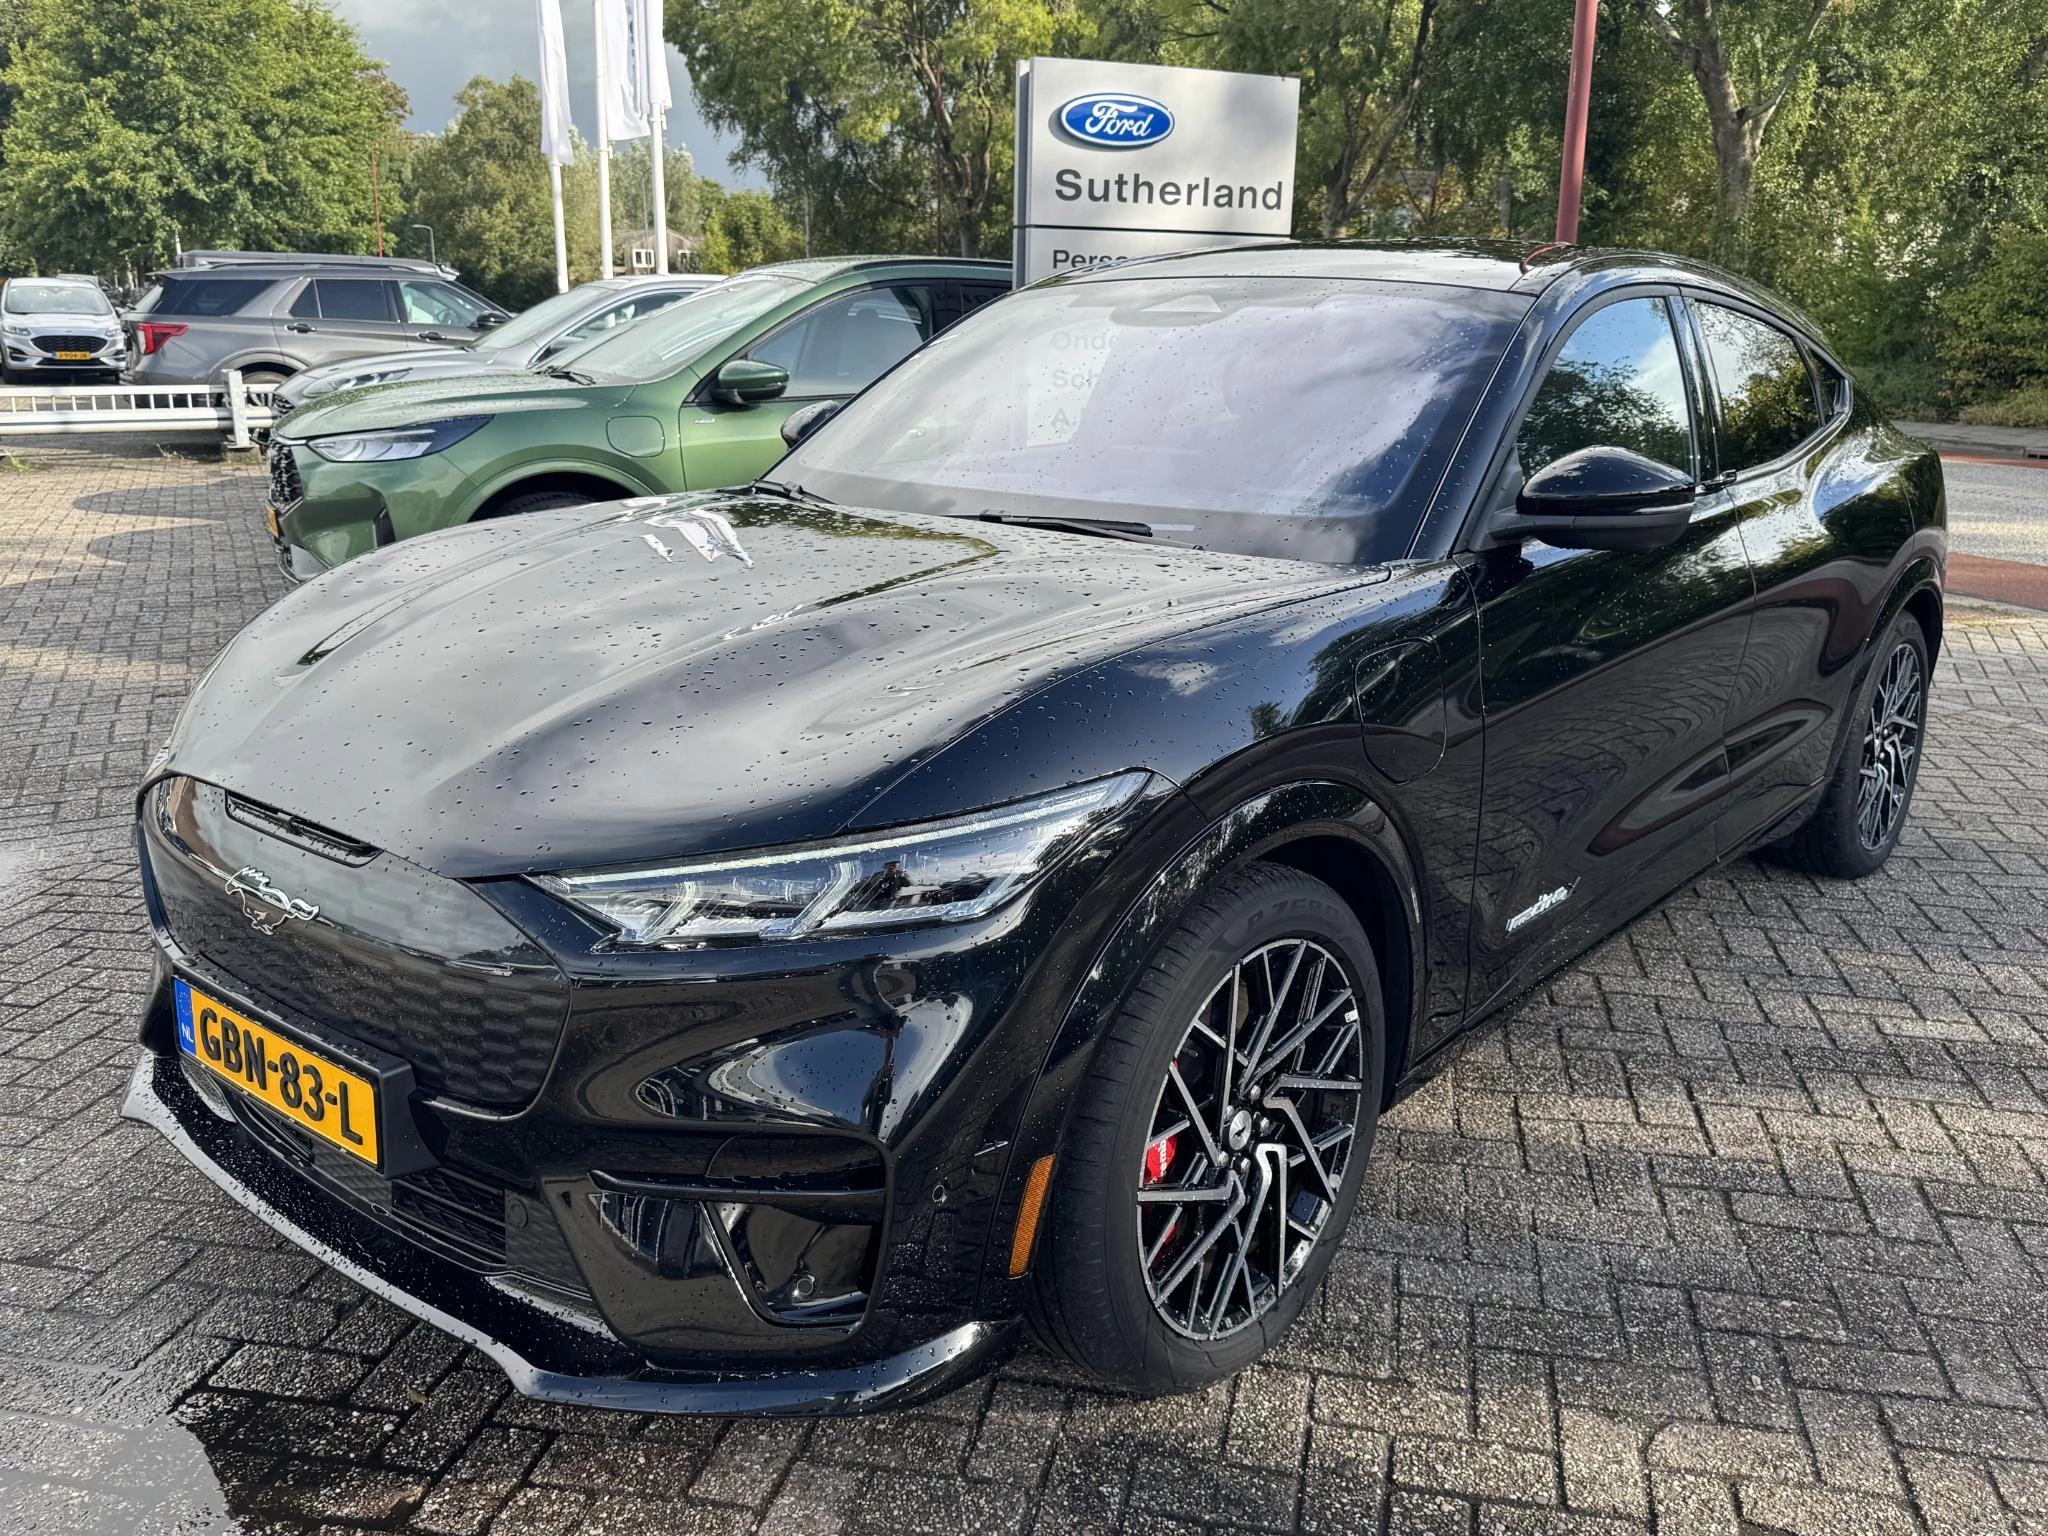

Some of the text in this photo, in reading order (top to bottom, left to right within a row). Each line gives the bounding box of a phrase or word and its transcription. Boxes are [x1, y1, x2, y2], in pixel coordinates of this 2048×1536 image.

[1085, 101, 1153, 138] Ford
[1055, 168, 1283, 211] Sutherland
[181, 1022, 194, 1044] NL
[199, 1007, 364, 1146] GBN-83-L
